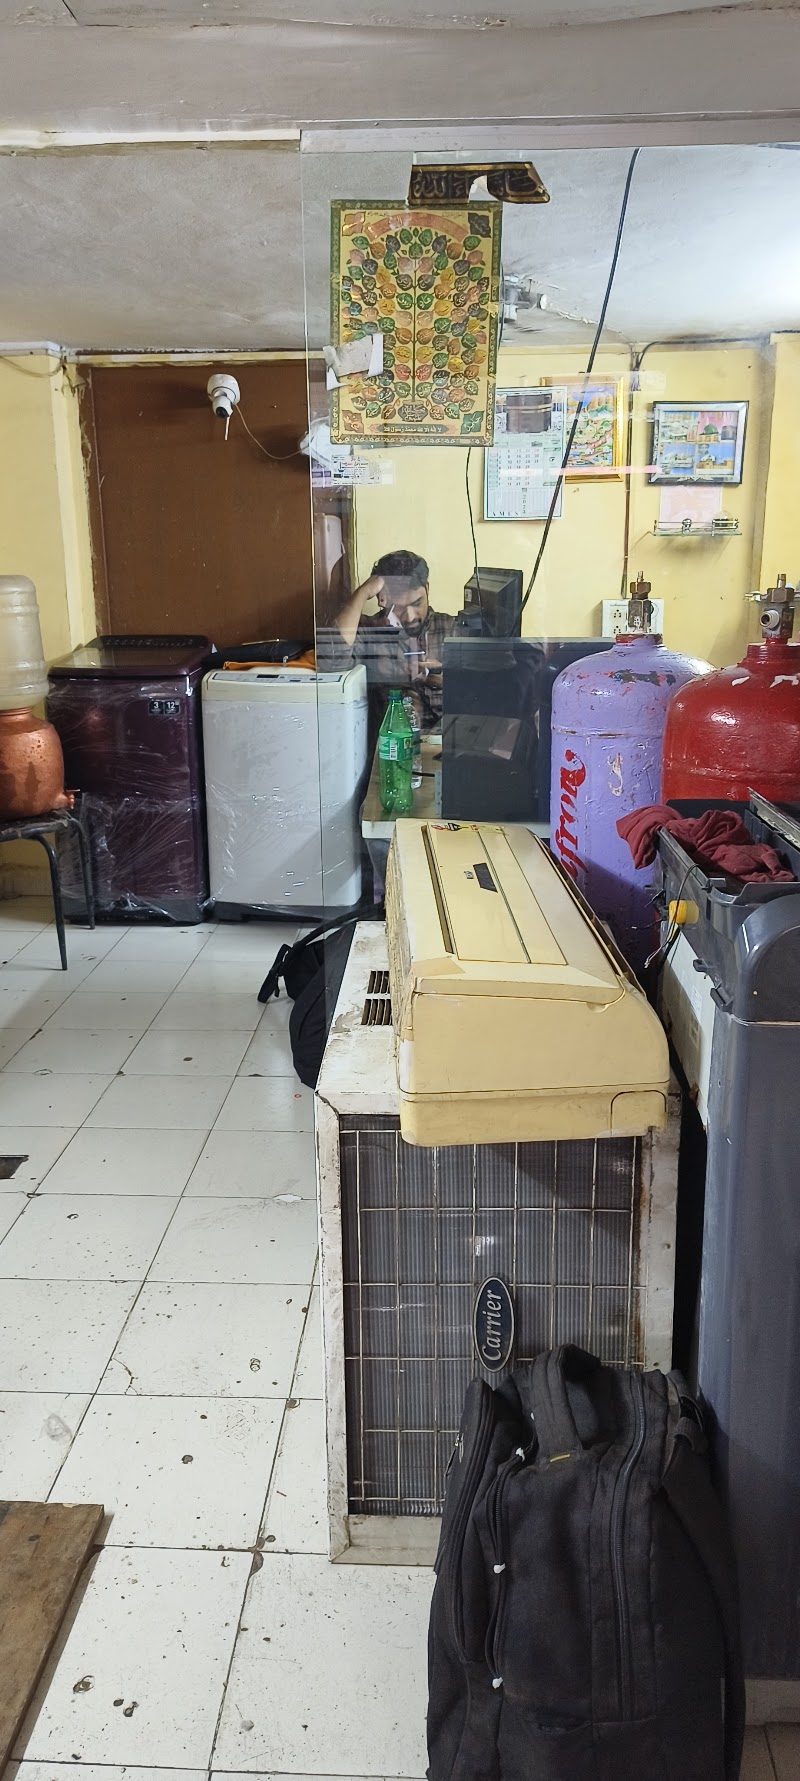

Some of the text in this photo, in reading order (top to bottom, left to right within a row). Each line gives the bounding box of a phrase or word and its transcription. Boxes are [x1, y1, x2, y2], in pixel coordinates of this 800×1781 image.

[153, 701, 159, 709] 3
[166, 701, 176, 709] 12
[482, 1289, 502, 1361] Carrier
